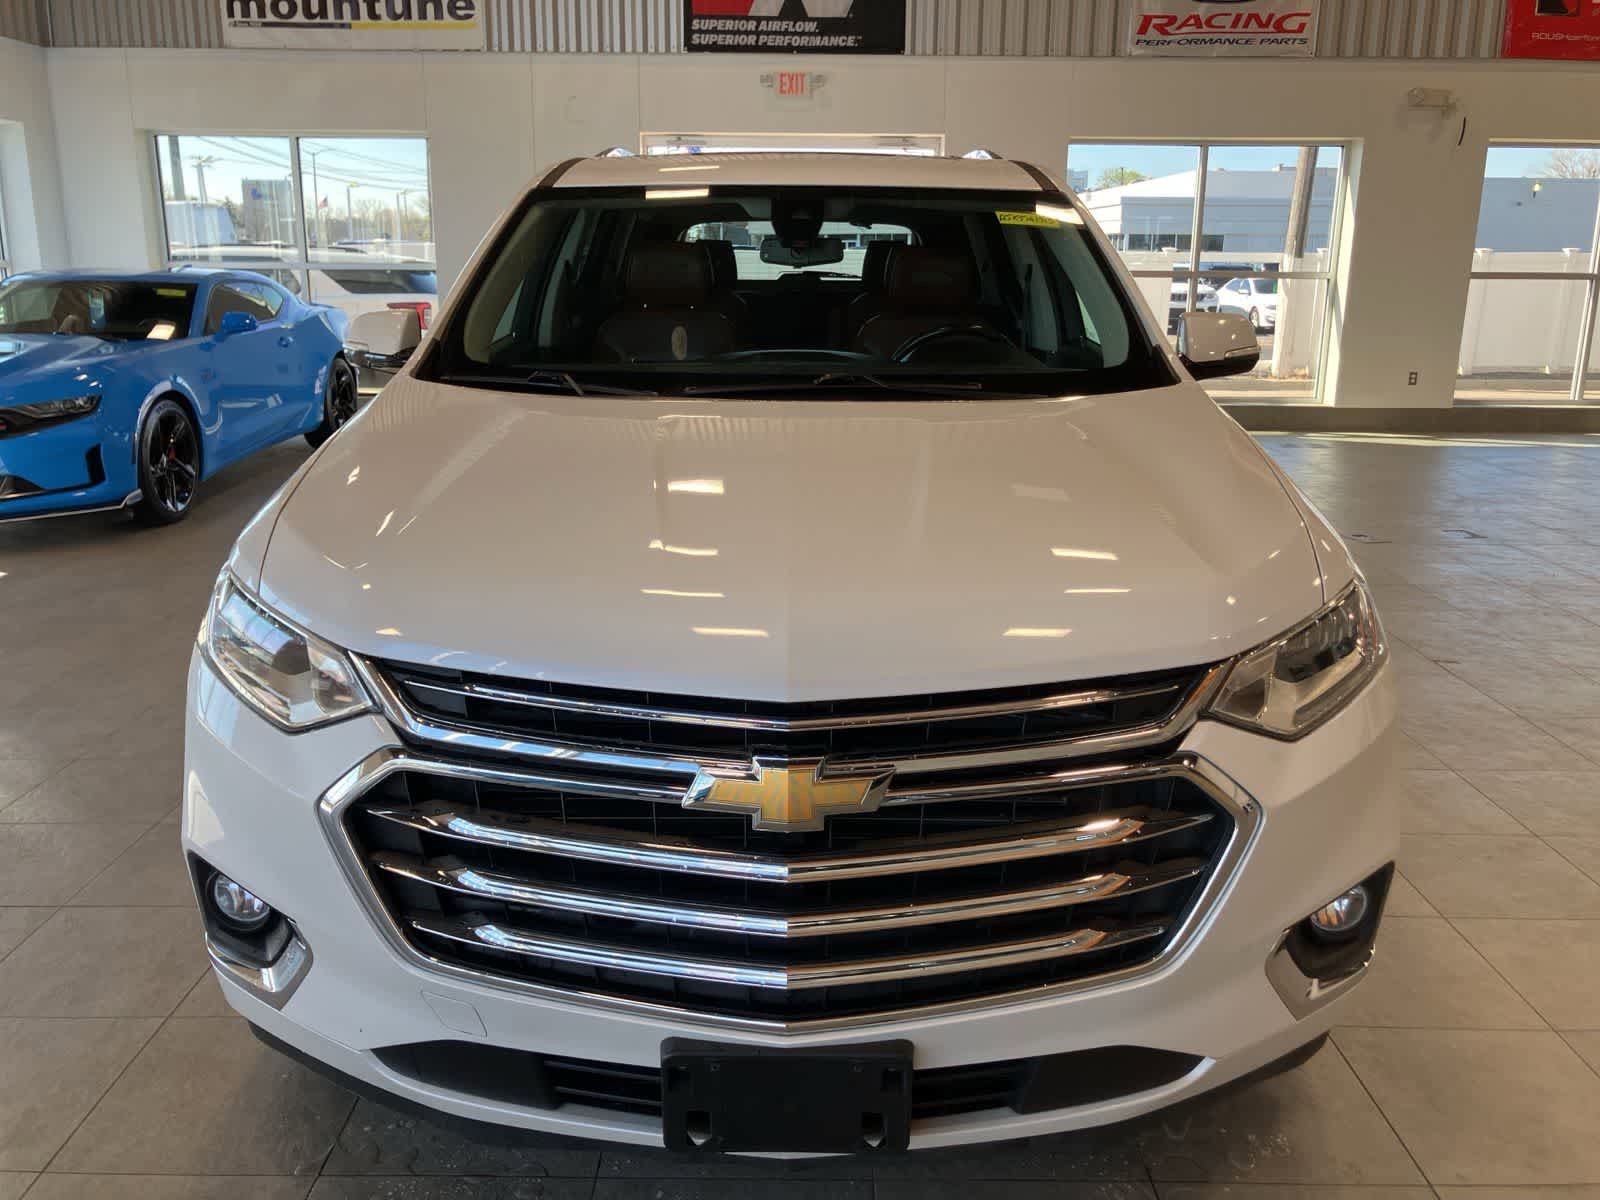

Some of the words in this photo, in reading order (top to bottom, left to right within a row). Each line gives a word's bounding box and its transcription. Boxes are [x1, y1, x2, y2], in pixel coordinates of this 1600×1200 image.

[227, 0, 476, 21] mountune
[691, 18, 757, 31] SUPERIOR
[758, 20, 820, 33] AIRFLOW.
[1135, 12, 1312, 36] RACING
[690, 33, 757, 46] SUPERIOR
[1135, 37, 1257, 46] PERFORMANCE
[1259, 37, 1309, 45] PARTS
[778, 72, 806, 95] EXIT
